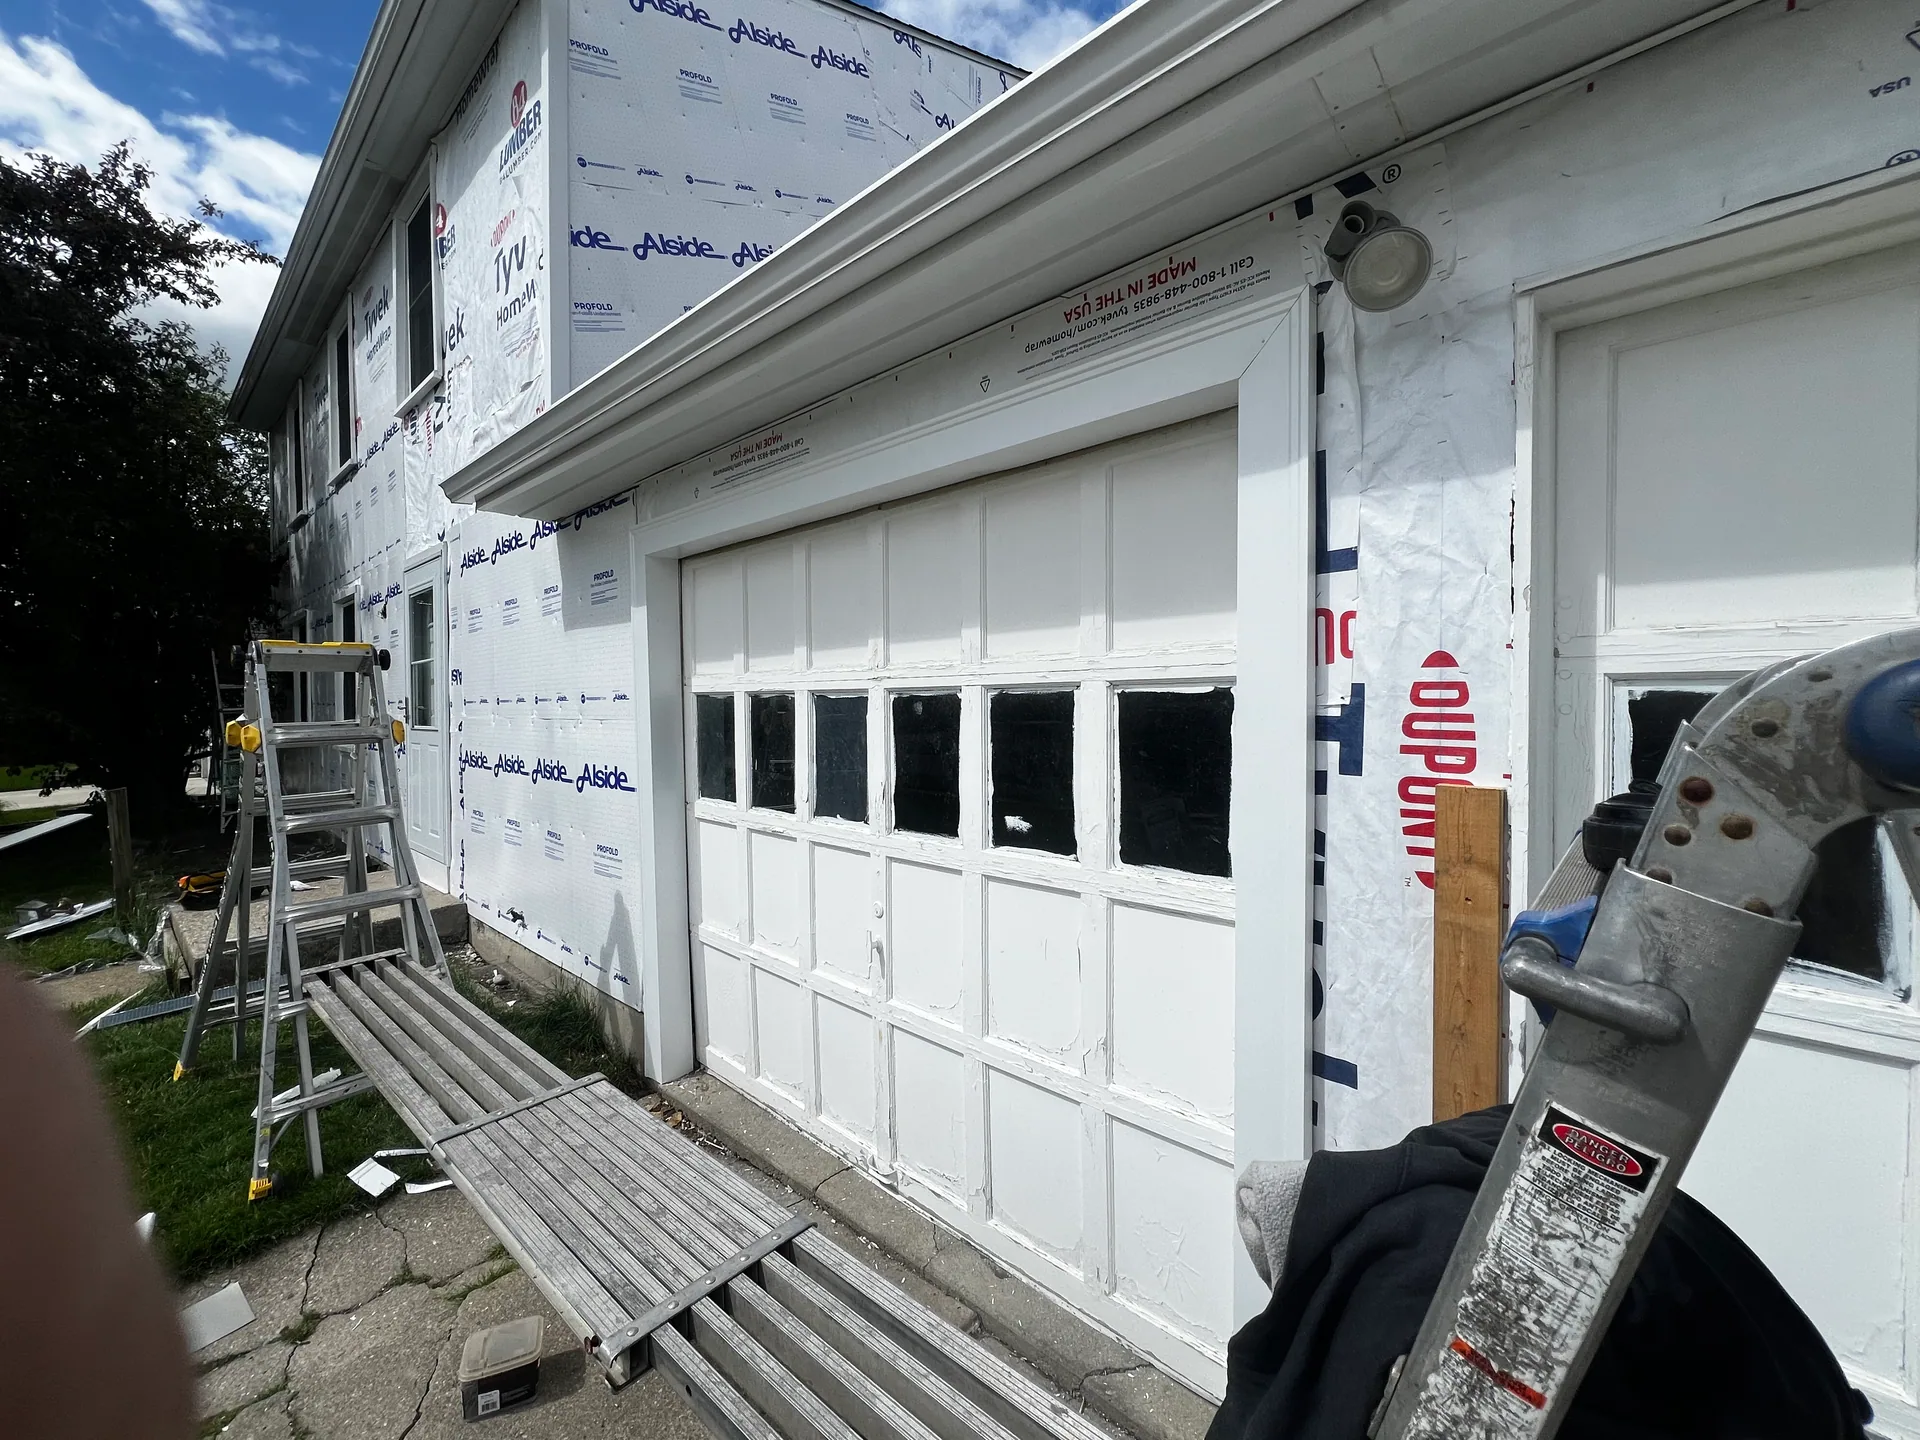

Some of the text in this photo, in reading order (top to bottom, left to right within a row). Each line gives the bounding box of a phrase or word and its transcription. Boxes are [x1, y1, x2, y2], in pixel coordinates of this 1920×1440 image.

[569, 39, 609, 56] PROFOLD
[728, 18, 806, 58] Alside
[811, 45, 870, 79] Alside
[680, 68, 712, 83] PROFOLD
[1868, 76, 1911, 98] USA
[770, 93, 798, 106] PROFOLD
[846, 113, 870, 125] PROFOLD
[499, 100, 542, 173] LUMBER
[637, 167, 664, 177] Alside
[633, 232, 726, 260] Alside
[1228, 255, 1255, 275] Call
[1062, 256, 1199, 323] MADE IN THE USA
[1132, 266, 1227, 312] 1-800-448-9835
[364, 284, 389, 343] Tyvek
[574, 302, 613, 311] PROFOLD
[1022, 304, 1129, 354] tyvek.com/homewrap
[728, 432, 784, 461] MADE IN THE USA
[793, 437, 804, 446] Call
[461, 546, 489, 577] Alside
[491, 530, 528, 565] Alside
[594, 569, 615, 582] PROFOLD
[613, 694, 630, 702] Alside
[461, 750, 636, 793] Alside Alside Alside Alside
[596, 844, 619, 857] PROFOLD
[1564, 1136, 1627, 1173] PELIGRO
[1568, 1128, 1629, 1163] DANGER
[1540, 1155, 1626, 1203] BEFORE USING LADDER
[1550, 1154, 1570, 1168] MUST
[1583, 1173, 1621, 1195] ENGAGED
[1552, 1149, 1586, 1170] LOCKING
[1587, 1168, 1639, 1197] MECHANISMS
